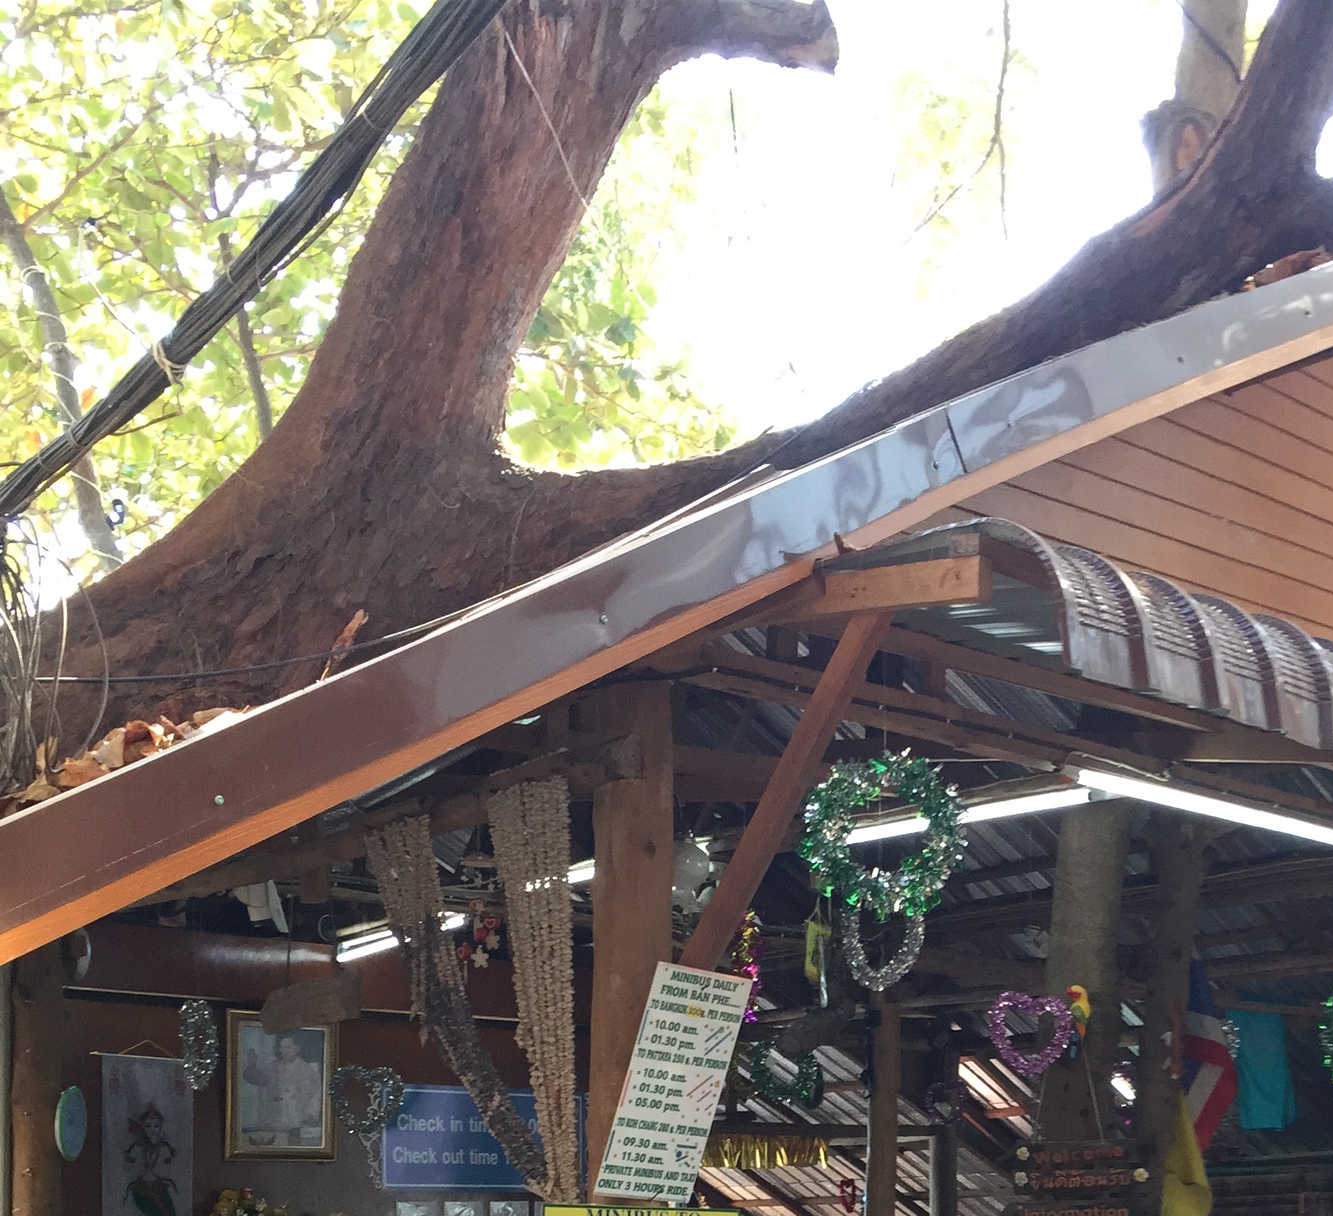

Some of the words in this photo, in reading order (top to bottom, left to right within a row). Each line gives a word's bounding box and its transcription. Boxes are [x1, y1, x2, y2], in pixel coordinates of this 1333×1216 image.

[670, 971, 712, 988] MINIBUS
[712, 979, 739, 992] DAILY
[660, 985, 689, 998] FROM
[690, 990, 711, 1003] BAN
[659, 1001, 688, 1014] BANGKOK
[719, 1012, 742, 1024] PERSON
[654, 1019, 681, 1033] 10.00
[682, 1025, 699, 1035] am.
[650, 1034, 677, 1047] 01.30
[678, 1040, 696, 1050] pm.
[645, 1050, 671, 1062] PATTAYA
[704, 1059, 728, 1070] PERSON
[643, 1067, 669, 1080] 10.00
[670, 1074, 687, 1083] am.
[639, 1082, 666, 1095] 01.30
[666, 1089, 684, 1098] pm.
[635, 1097, 662, 1109] 05.00
[663, 1103, 681, 1113] pm.
[397, 1114, 444, 1132] Check
[450, 1116, 463, 1132] in
[469, 1117, 491, 1133] tim
[687, 1126, 709, 1137] PERSON
[623, 1136, 650, 1150] 09.30
[652, 1141, 668, 1151] am.
[393, 1146, 437, 1165] Check
[442, 1149, 465, 1165] out
[470, 1150, 499, 1165] time
[621, 1151, 646, 1163] 11.30
[647, 1156, 664, 1165] am.
[603, 1164, 632, 1175] PRIVATE
[632, 1166, 663, 1179] MINIBUS
[664, 1171, 679, 1181] AND
[598, 1178, 623, 1190] ONLY
[625, 1181, 631, 1190] 3
[633, 1182, 665, 1193] HOURS
